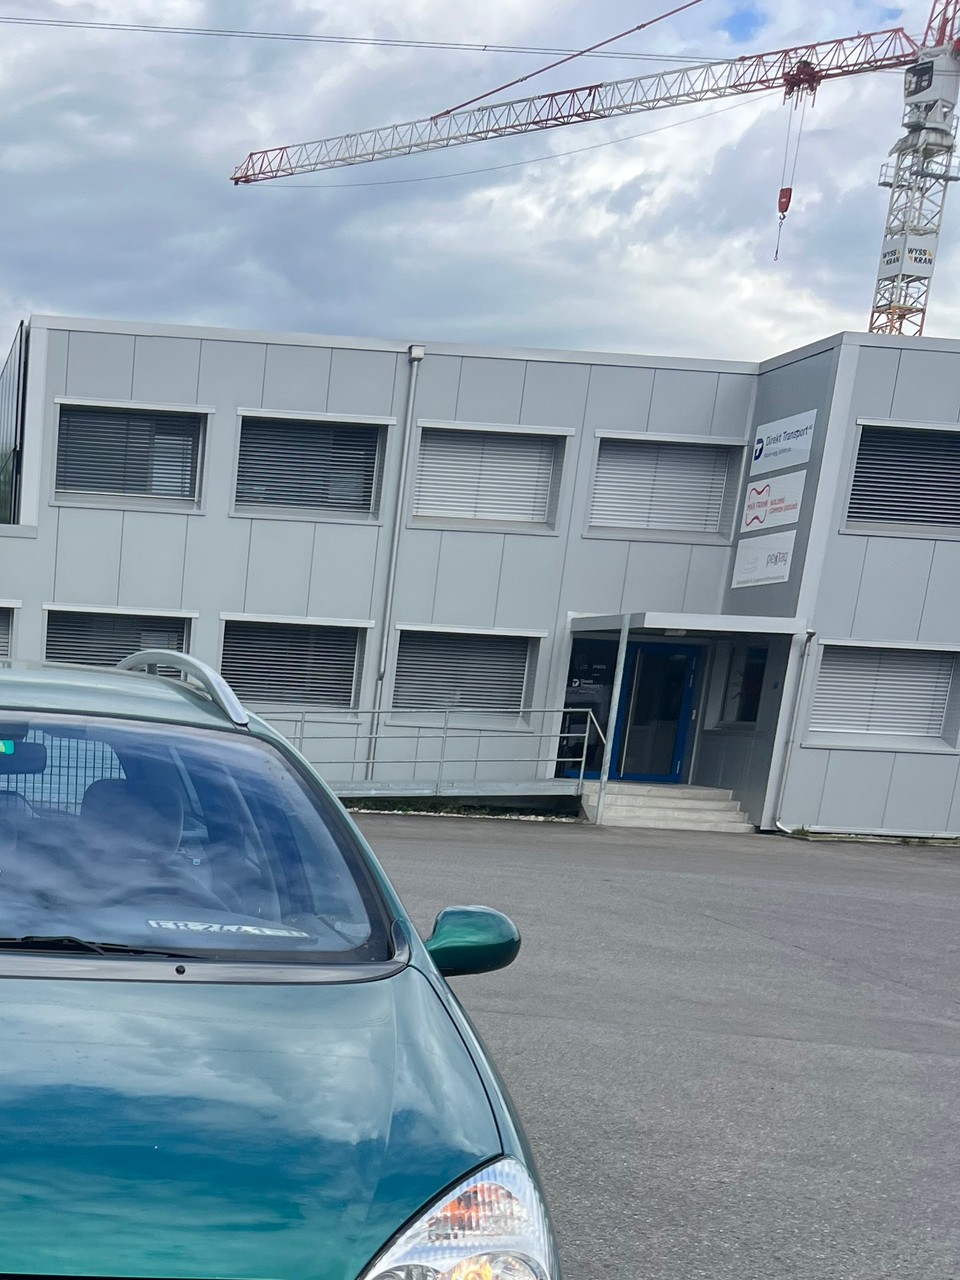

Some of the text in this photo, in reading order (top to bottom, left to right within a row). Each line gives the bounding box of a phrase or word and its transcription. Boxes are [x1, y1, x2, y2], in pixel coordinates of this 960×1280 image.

[883, 249, 897, 259] WYSS
[907, 248, 928, 256] WYSS
[886, 256, 900, 265] KRAN
[914, 256, 933, 265] KRAN
[765, 434, 782, 446] Direkt
[783, 425, 809, 441] Transport
